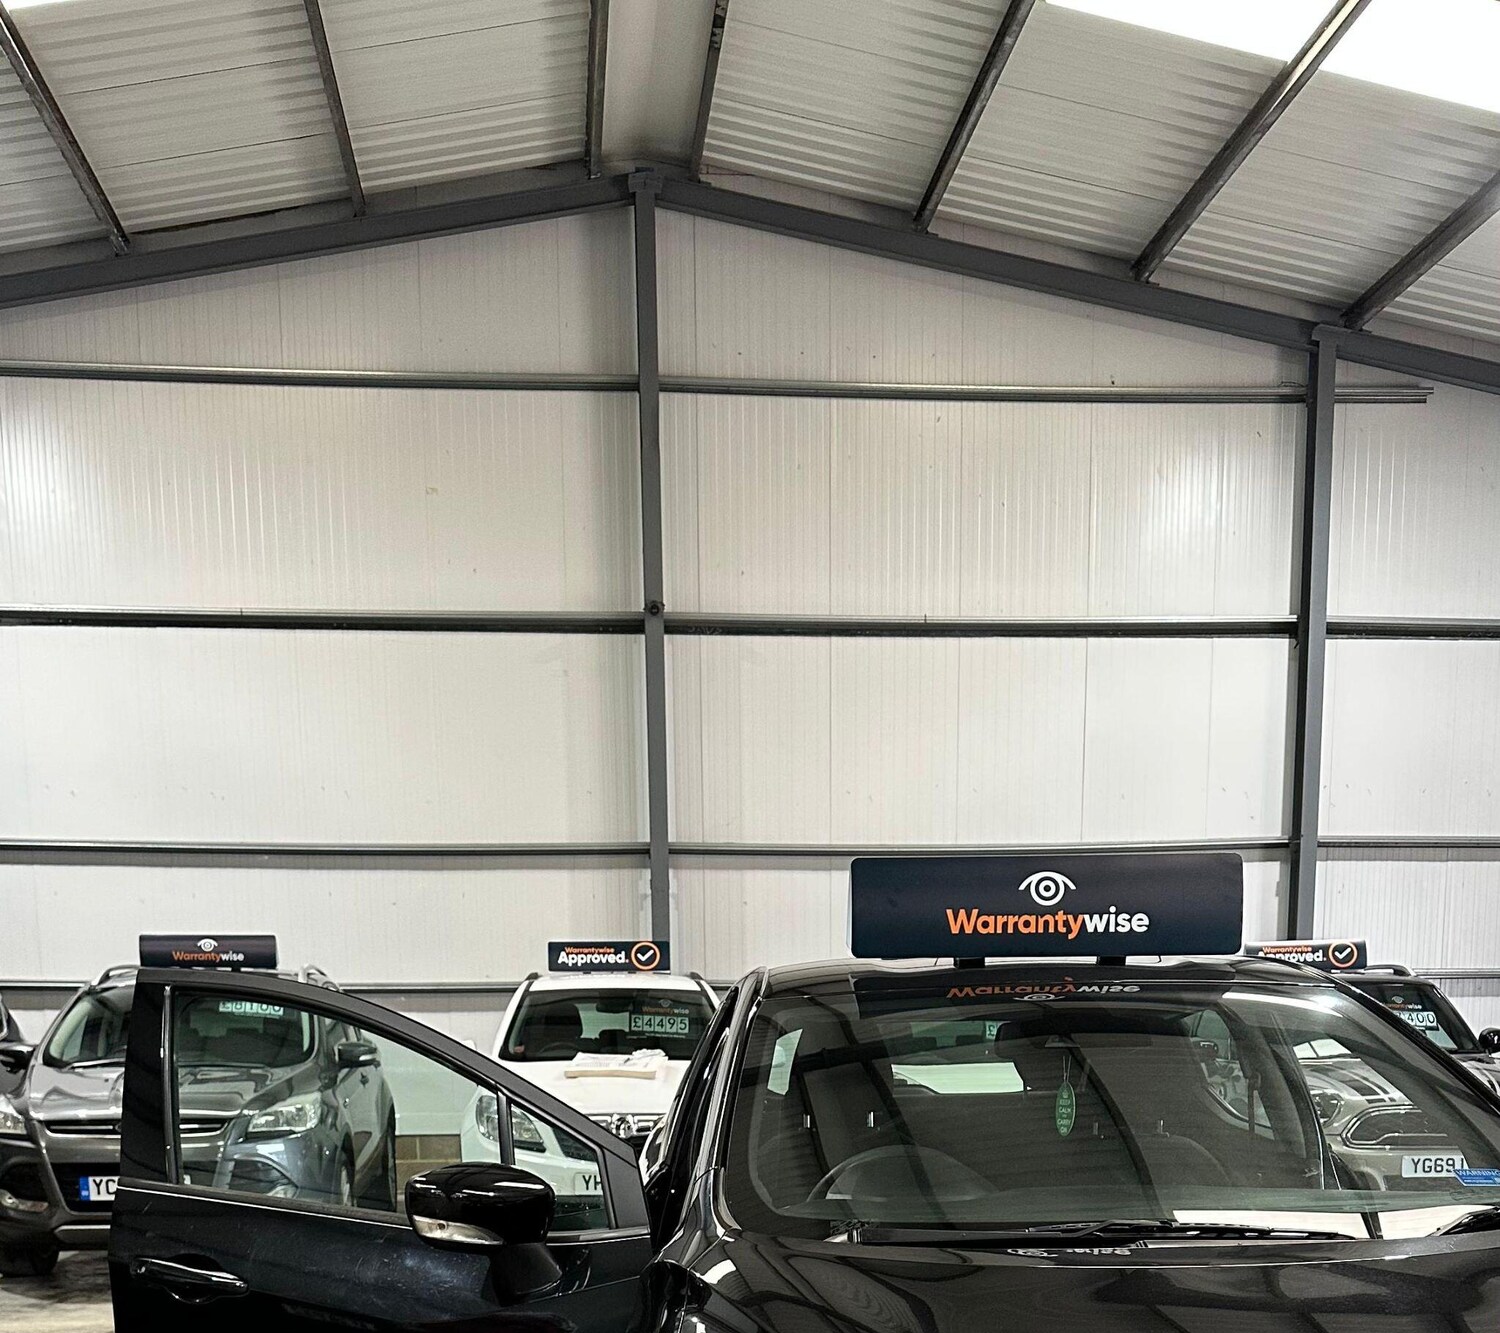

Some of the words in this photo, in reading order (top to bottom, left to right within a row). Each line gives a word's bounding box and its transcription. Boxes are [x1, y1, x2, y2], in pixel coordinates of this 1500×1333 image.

[946, 905, 1150, 940] Warrantywise
[172, 950, 245, 963] Warrantywise
[564, 946, 615, 954] Warrantywise
[1262, 946, 1313, 954] Warrantywise
[557, 950, 630, 967] Approved.
[633, 1016, 688, 1031] £4495
[1411, 1157, 1456, 1174] YG69
